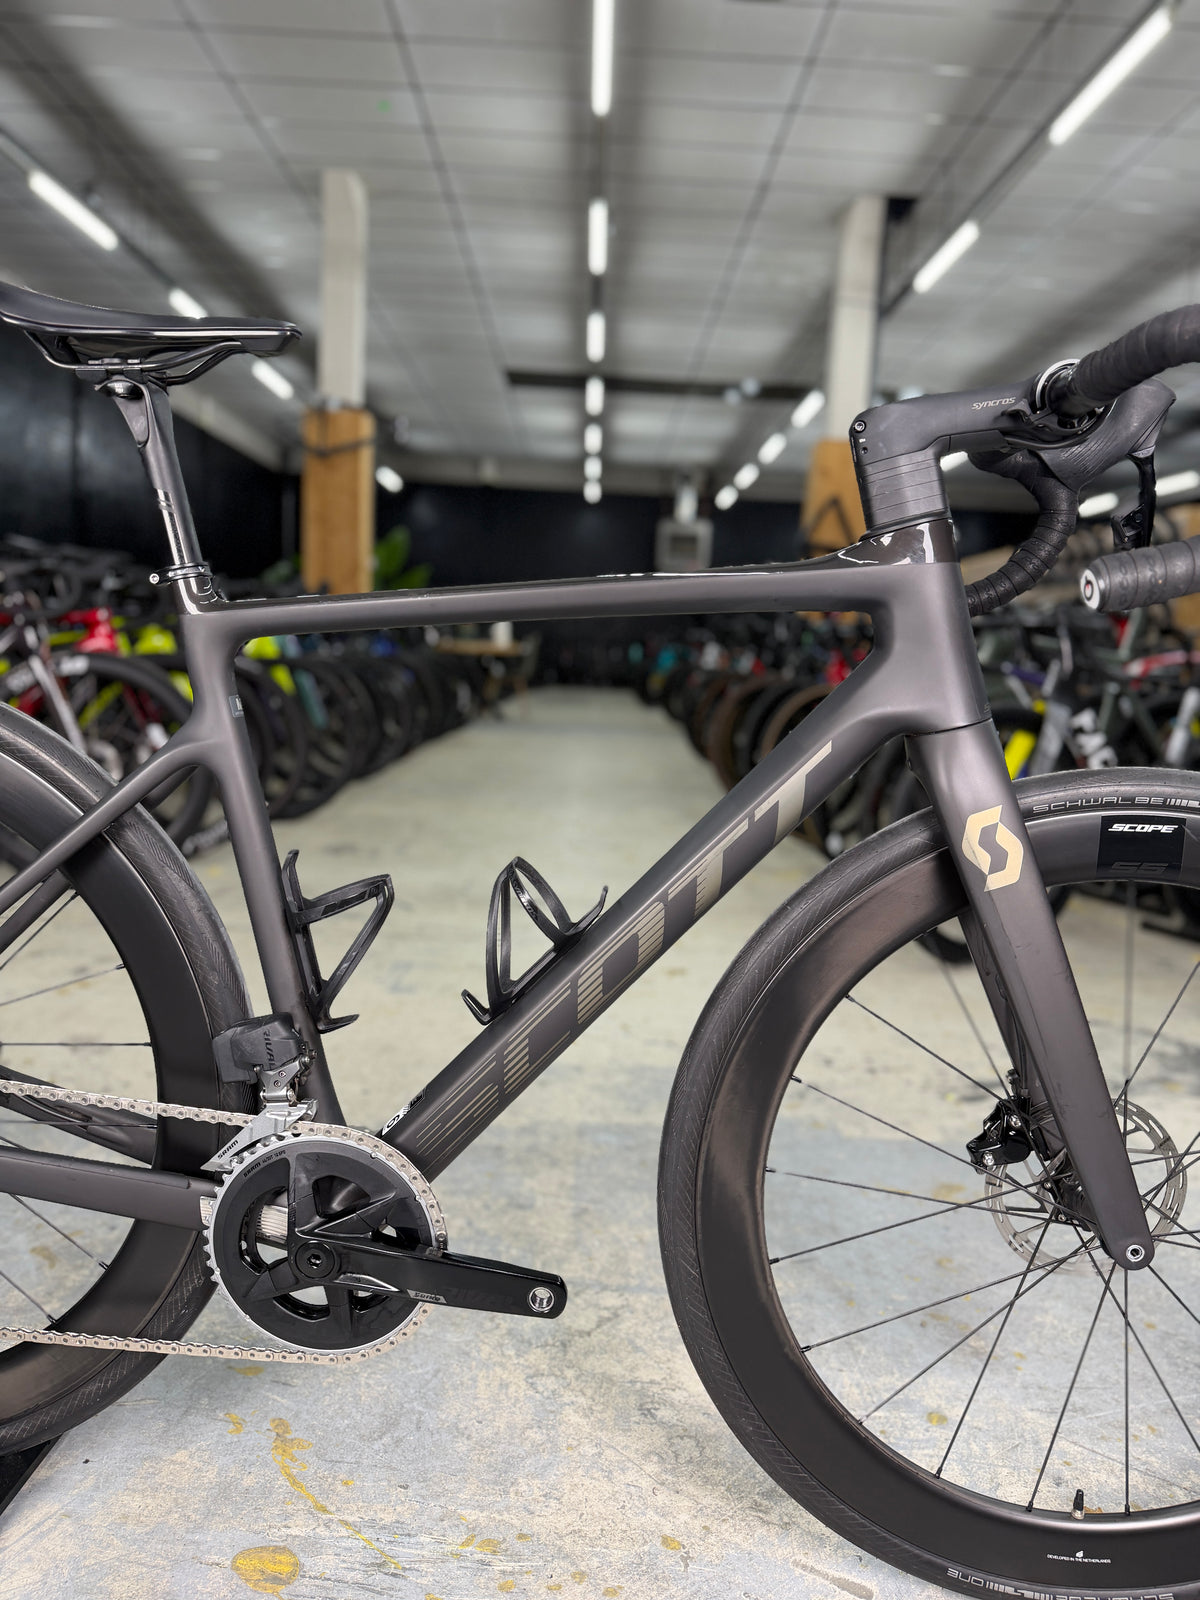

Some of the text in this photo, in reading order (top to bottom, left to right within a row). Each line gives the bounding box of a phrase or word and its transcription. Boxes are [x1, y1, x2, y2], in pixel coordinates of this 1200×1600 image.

[971, 396, 1017, 410] syncros
[1032, 796, 1164, 814] SCHWALBE
[1107, 823, 1179, 834] SCOPE
[217, 1139, 239, 1159] SRAM
[946, 1567, 985, 1587] ONE
